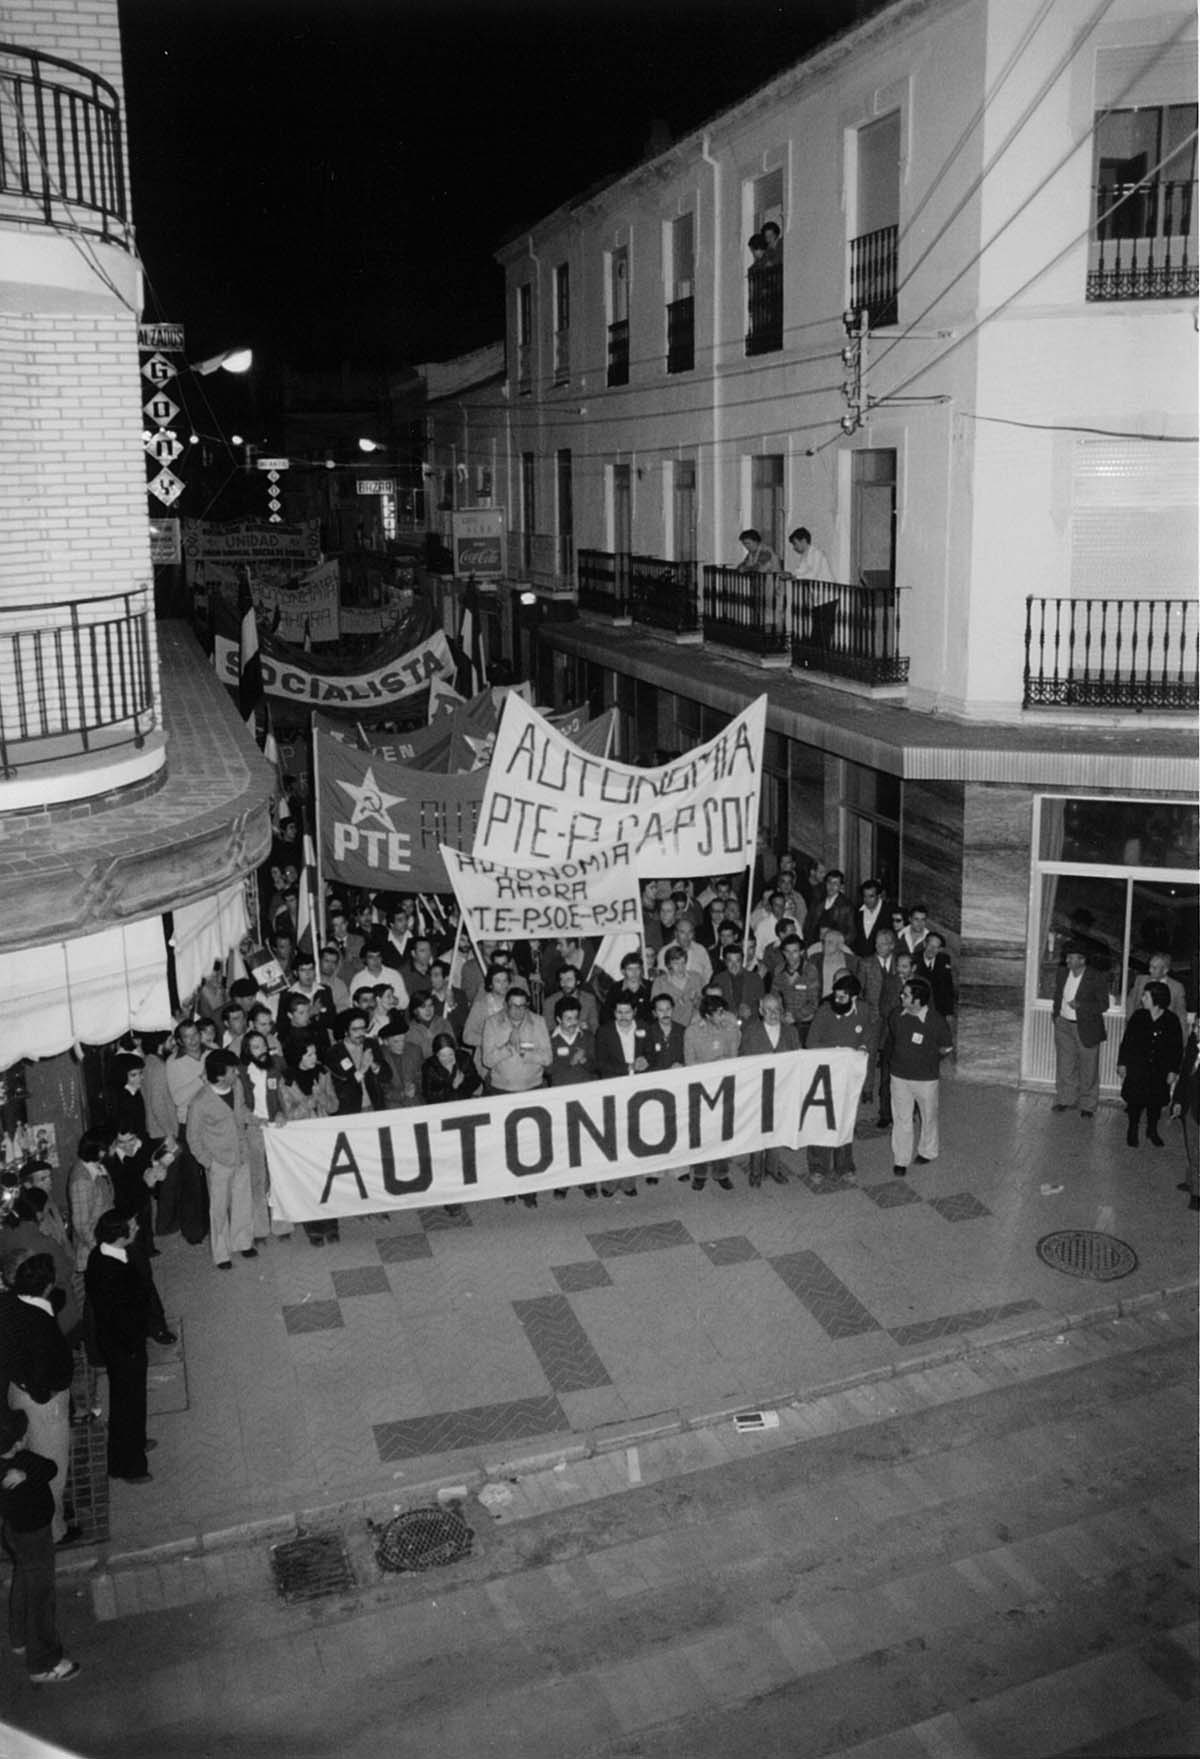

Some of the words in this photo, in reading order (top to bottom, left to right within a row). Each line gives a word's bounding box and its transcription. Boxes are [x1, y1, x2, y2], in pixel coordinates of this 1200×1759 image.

[225, 534, 280, 549] UNIDAD
[225, 649, 445, 702] SOCIALISTA
[505, 720, 756, 805] AUTONOMIA
[333, 820, 412, 873] PTE
[455, 842, 631, 882] AUTONOMIA
[319, 1063, 837, 1205] AUTONOMIA
